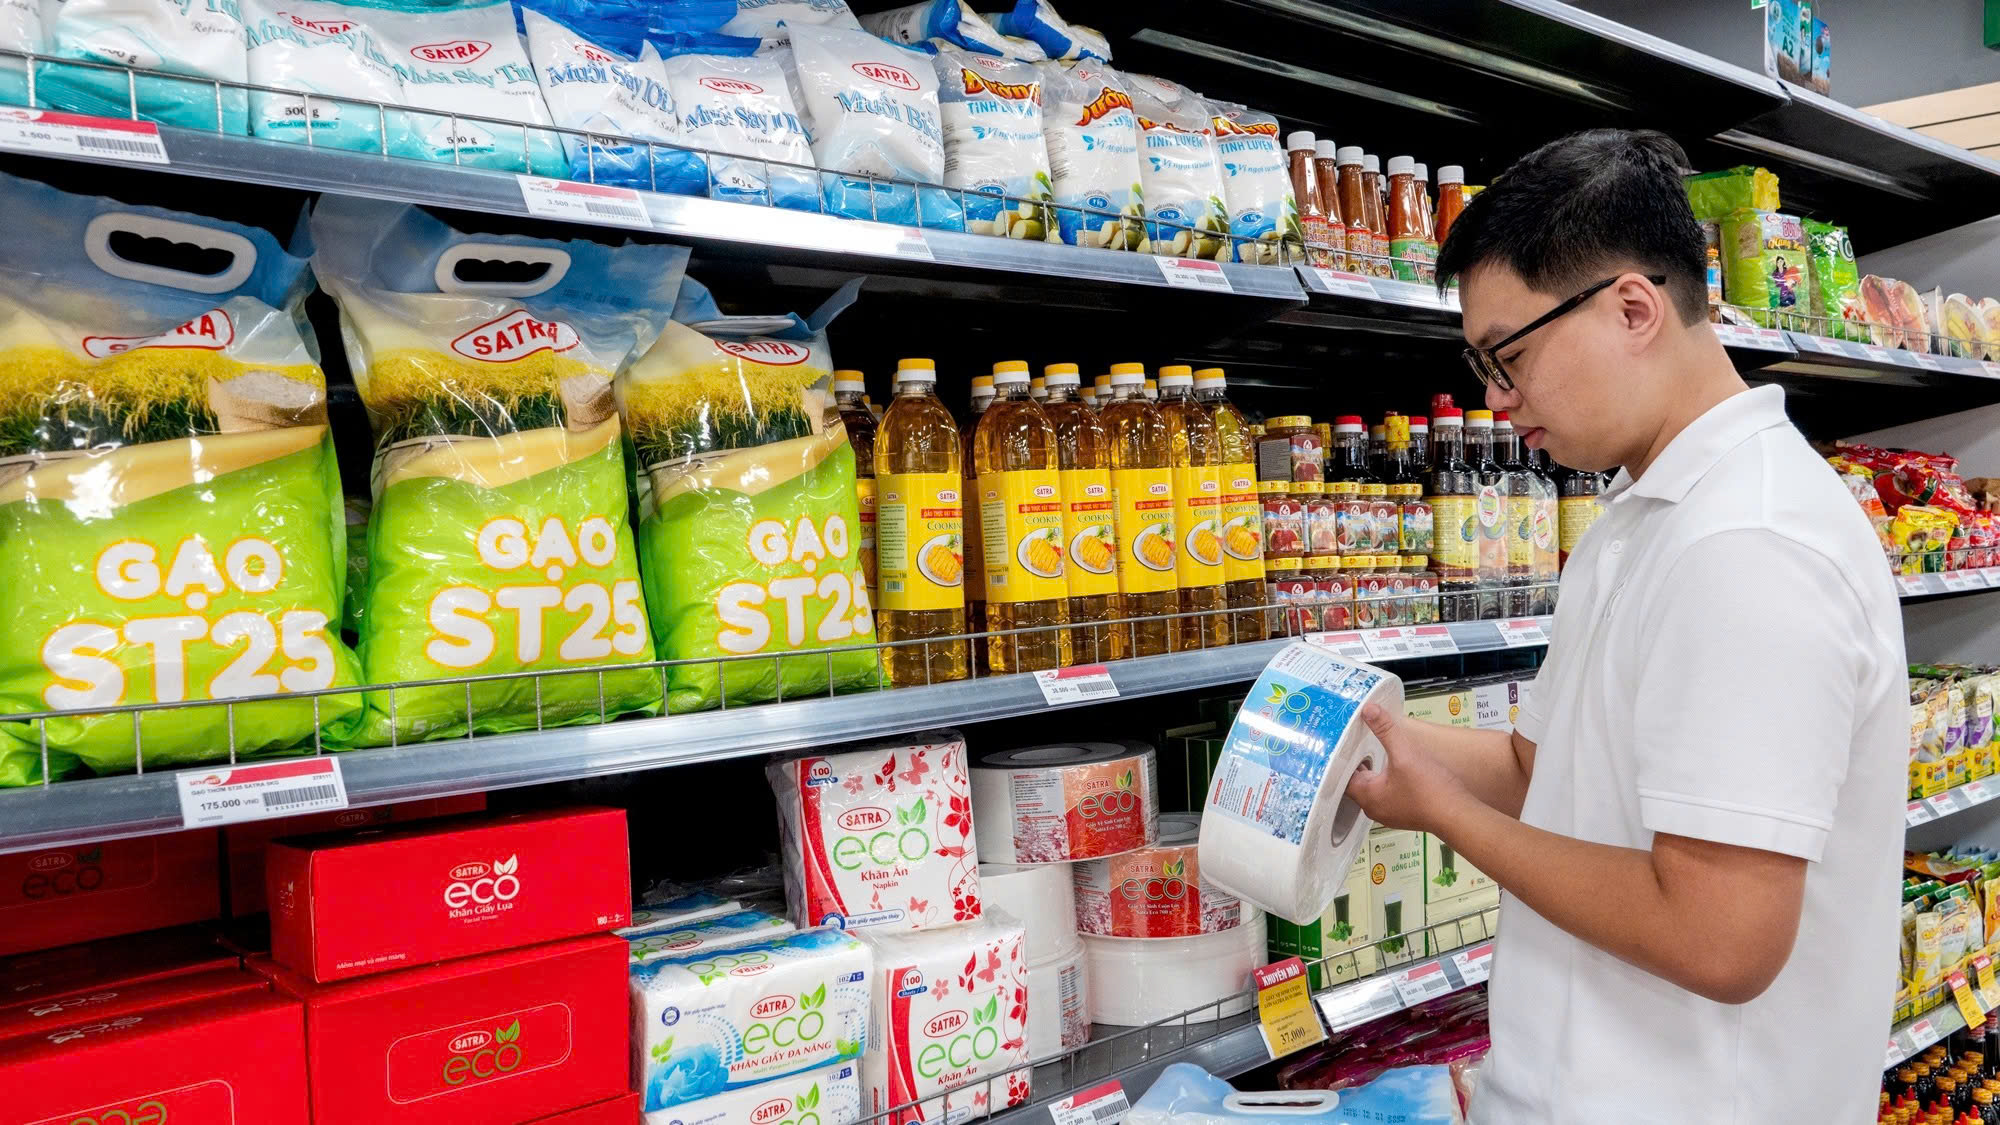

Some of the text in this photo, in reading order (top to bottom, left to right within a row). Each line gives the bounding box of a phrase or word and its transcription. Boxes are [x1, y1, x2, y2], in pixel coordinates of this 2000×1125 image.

[422, 43, 480, 60] SATRA
[862, 66, 912, 87] SATRA
[312, 108, 320, 118] g
[475, 318, 558, 355] SATRA
[1087, 486, 1104, 495] SATRA
[1151, 485, 1167, 493] SATRA
[1202, 482, 1216, 490] SATRA
[1234, 479, 1249, 487] SATRA
[1036, 488, 1053, 496] SATRA
[1026, 514, 1060, 525] COOKIN
[1141, 511, 1173, 521] COOKIN
[927, 520, 962, 531] COOKIN
[477, 516, 617, 582] GẠO
[748, 515, 849, 573] GẠO
[95, 535, 283, 610] GẠO
[717, 570, 874, 655] ST25
[426, 579, 648, 669] ST25
[43, 610, 336, 714] ST25
[1476, 700, 1489, 710] Bột
[812, 767, 829, 777] 100
[1086, 779, 1110, 790] SATRA
[200, 799, 241, 812] 175.000
[1078, 789, 1135, 819] eco
[846, 811, 883, 827] SATRA
[833, 827, 930, 871] eco
[1400, 849, 1420, 860] RAU MÁ
[35, 857, 66, 868] SATRA
[1130, 865, 1154, 873] SATRA
[1391, 862, 1408, 873] UỐNG
[456, 866, 485, 878] SATRA
[860, 865, 909, 882] Khăn Ăn
[22, 866, 104, 900] eco
[873, 880, 899, 891] Napkin
[1121, 877, 1186, 901] eco
[444, 874, 520, 909] eco
[449, 901, 513, 919] Khăn Giấy Lụa
[687, 952, 769, 975] eco
[838, 976, 850, 984] 102
[904, 974, 921, 986] 100
[1262, 968, 1287, 987] KHUYẾN
[756, 1000, 788, 1015] SATRA
[930, 1014, 961, 1035] SATRA
[743, 1011, 824, 1055] eco
[455, 1034, 485, 1050] SATRA
[730, 1040, 833, 1073] KHĂN GIẤY ĐA NĂNG
[917, 1026, 998, 1079] eco
[443, 1042, 521, 1085] eco
[828, 1072, 839, 1081] 102
[937, 1065, 977, 1086] Khăn Ăn
[756, 1103, 786, 1122] SATRA
